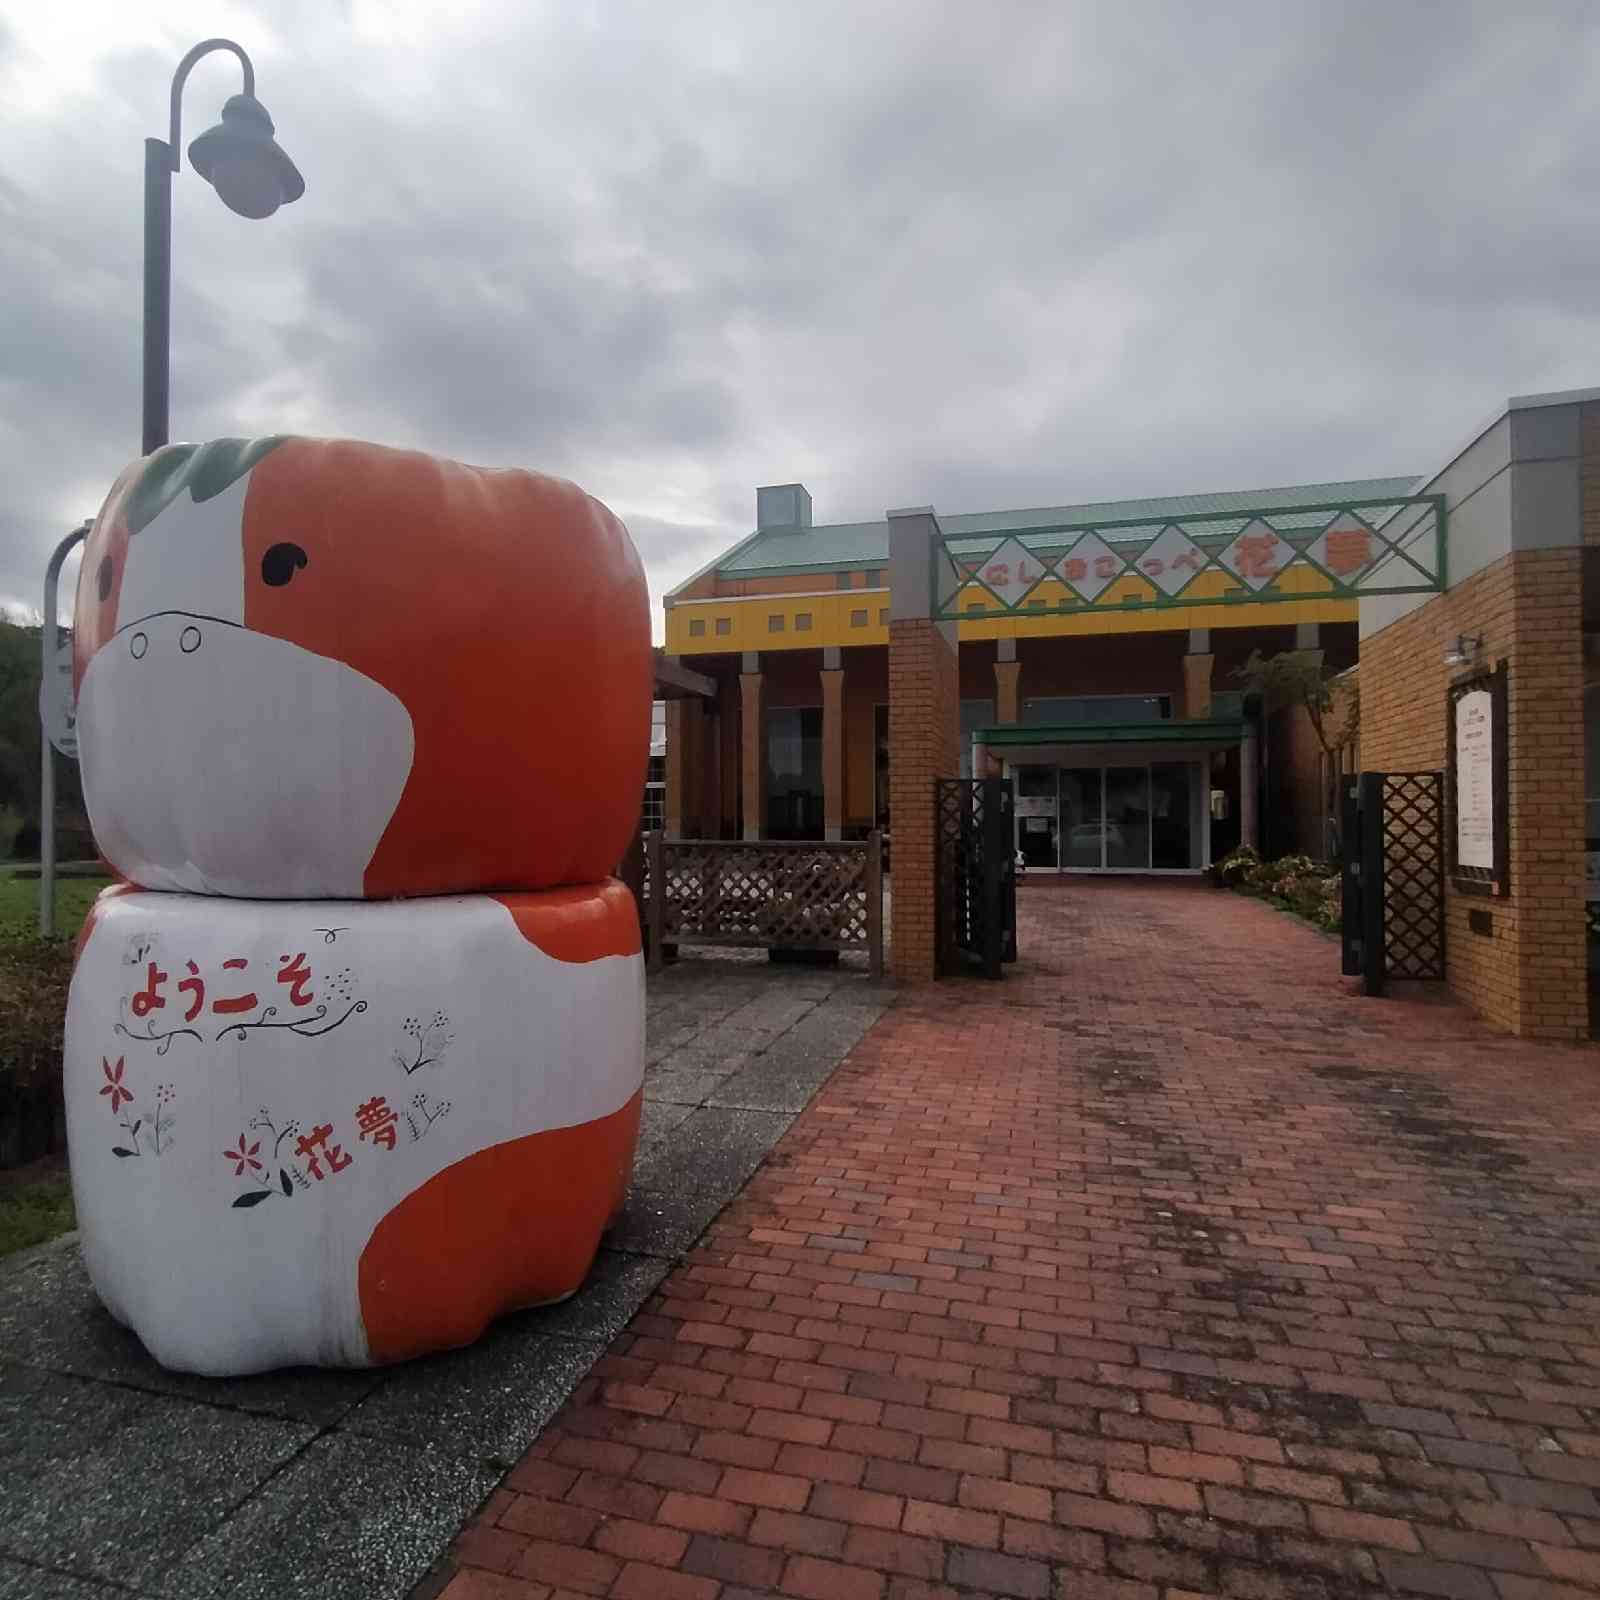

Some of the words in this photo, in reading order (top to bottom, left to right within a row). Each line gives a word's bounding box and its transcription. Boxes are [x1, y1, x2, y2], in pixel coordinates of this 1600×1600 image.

[131, 952, 314, 1022] ようこそ
[295, 1096, 400, 1180] 花夢
